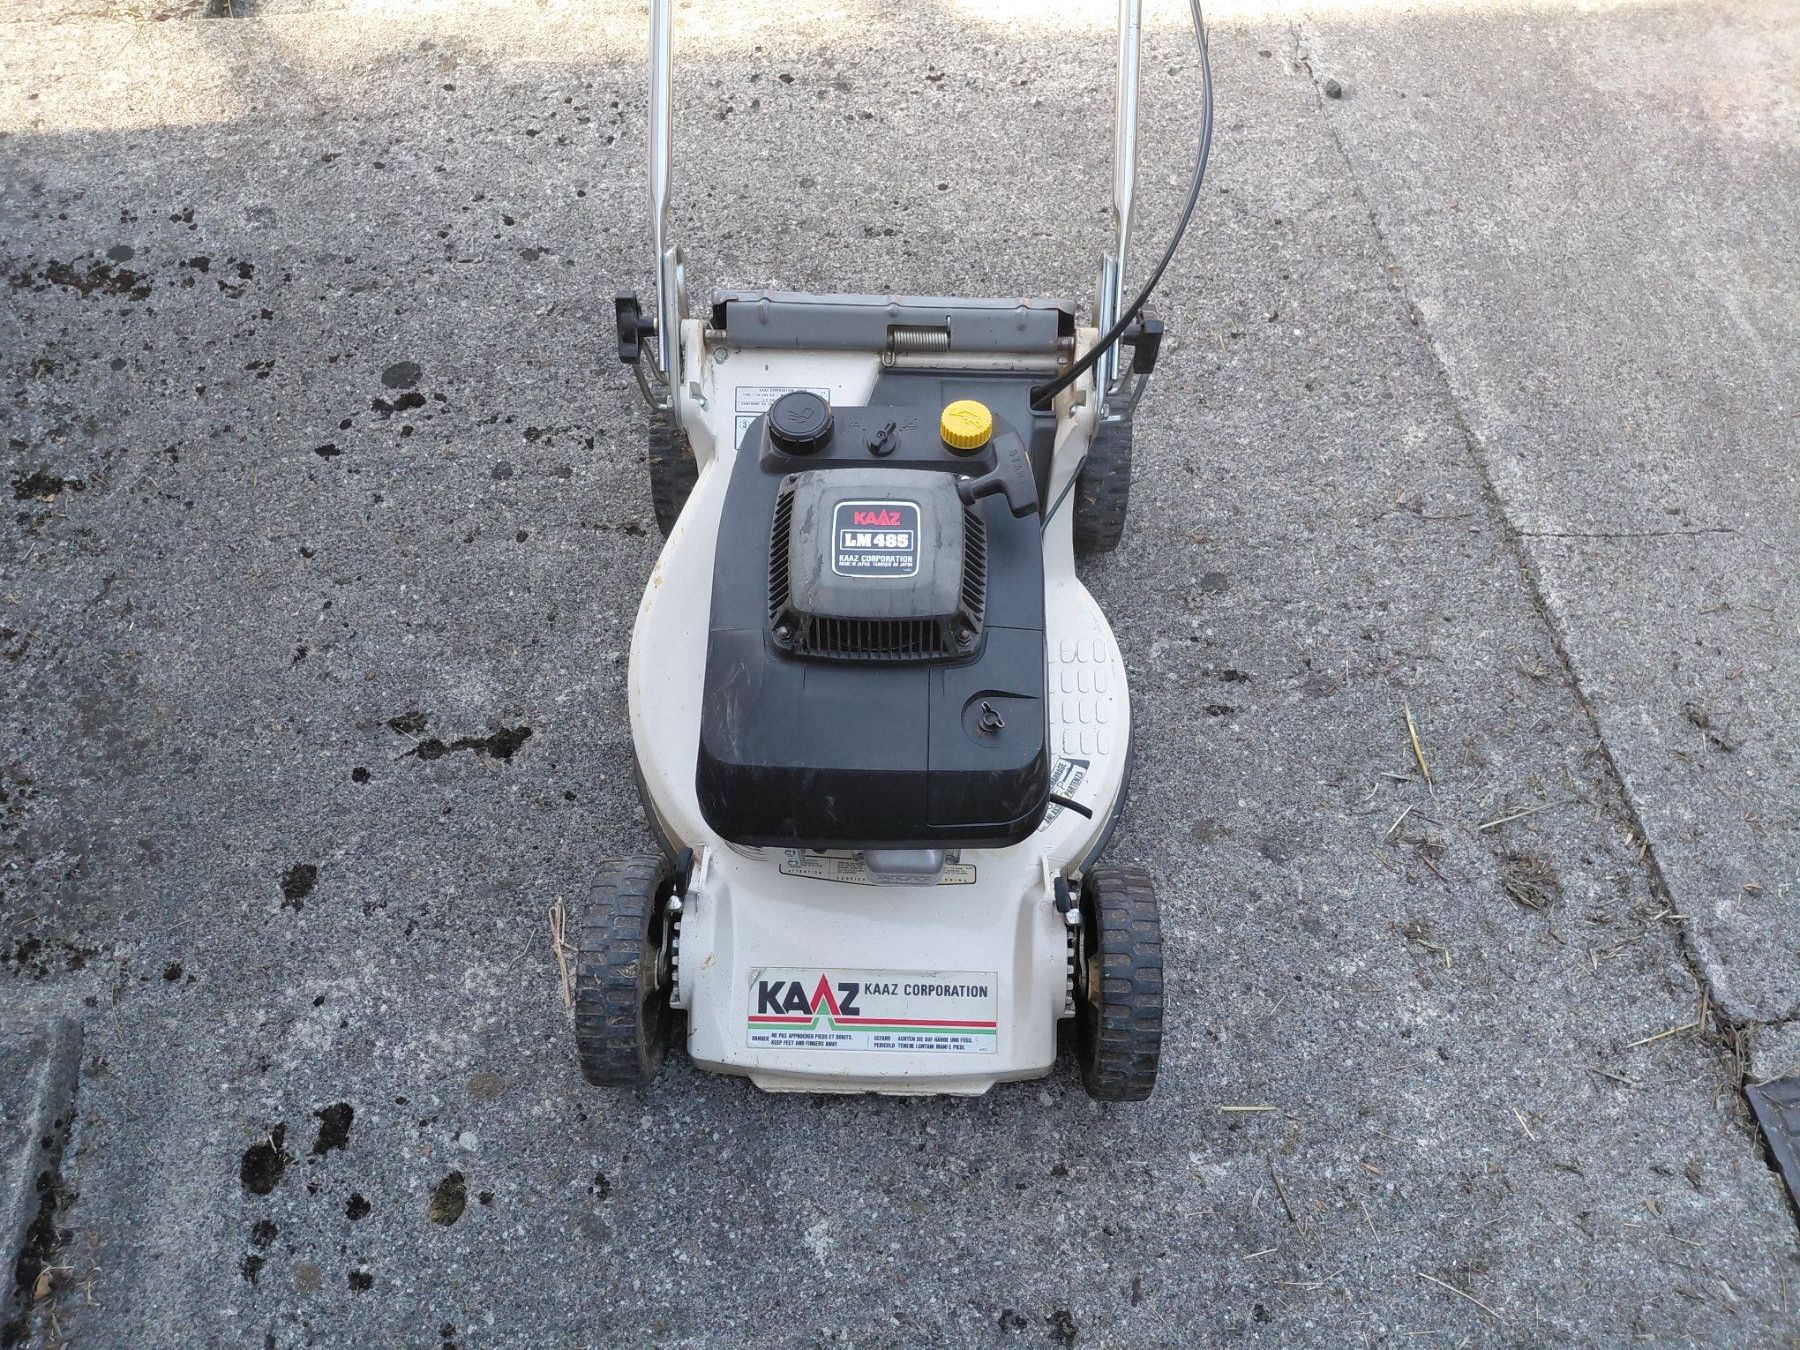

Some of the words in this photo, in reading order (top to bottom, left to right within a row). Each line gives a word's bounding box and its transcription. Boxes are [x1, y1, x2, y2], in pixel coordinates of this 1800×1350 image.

[854, 508, 901, 526] KAAZ
[844, 533, 872, 547] LM
[872, 533, 909, 548] 485
[861, 555, 913, 563] CORPORATION
[758, 973, 860, 1015] KAAZ
[864, 983, 899, 996] KAAZ
[903, 984, 988, 998] CORPORATION
